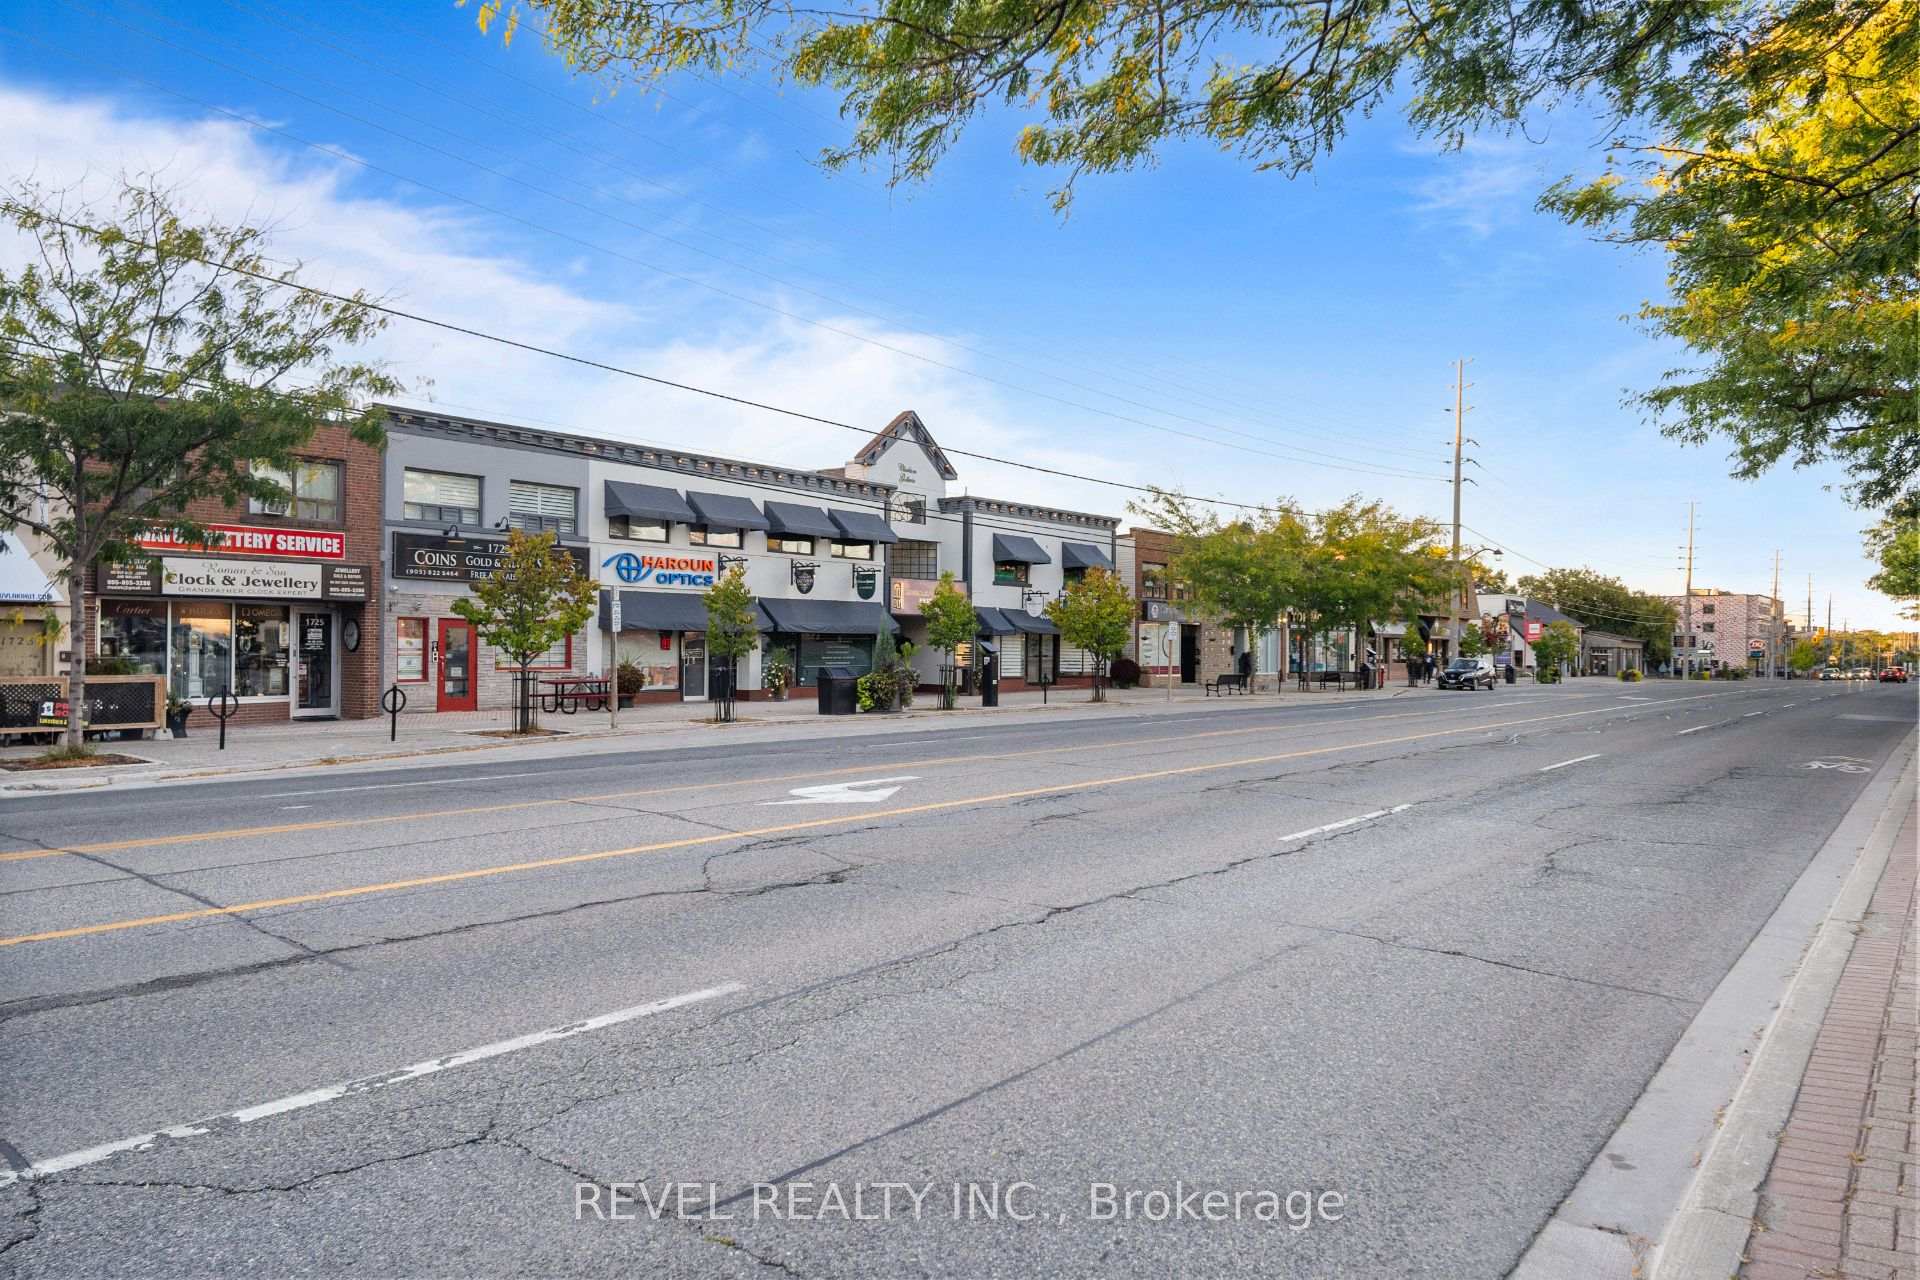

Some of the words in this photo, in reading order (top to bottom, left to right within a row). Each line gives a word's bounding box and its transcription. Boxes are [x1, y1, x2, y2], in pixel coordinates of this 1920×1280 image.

[202, 530, 275, 550] TTERY
[276, 534, 341, 553] SERVICE
[414, 550, 457, 567] COINS
[465, 556, 492, 567] GOLD
[494, 557, 501, 567] &
[641, 556, 714, 572] HAROUN
[167, 571, 216, 586] Clock
[222, 575, 236, 586] &
[241, 576, 318, 592] Jewellery
[655, 572, 714, 586] OPTICS
[178, 585, 243, 594] GRANDFATHER
